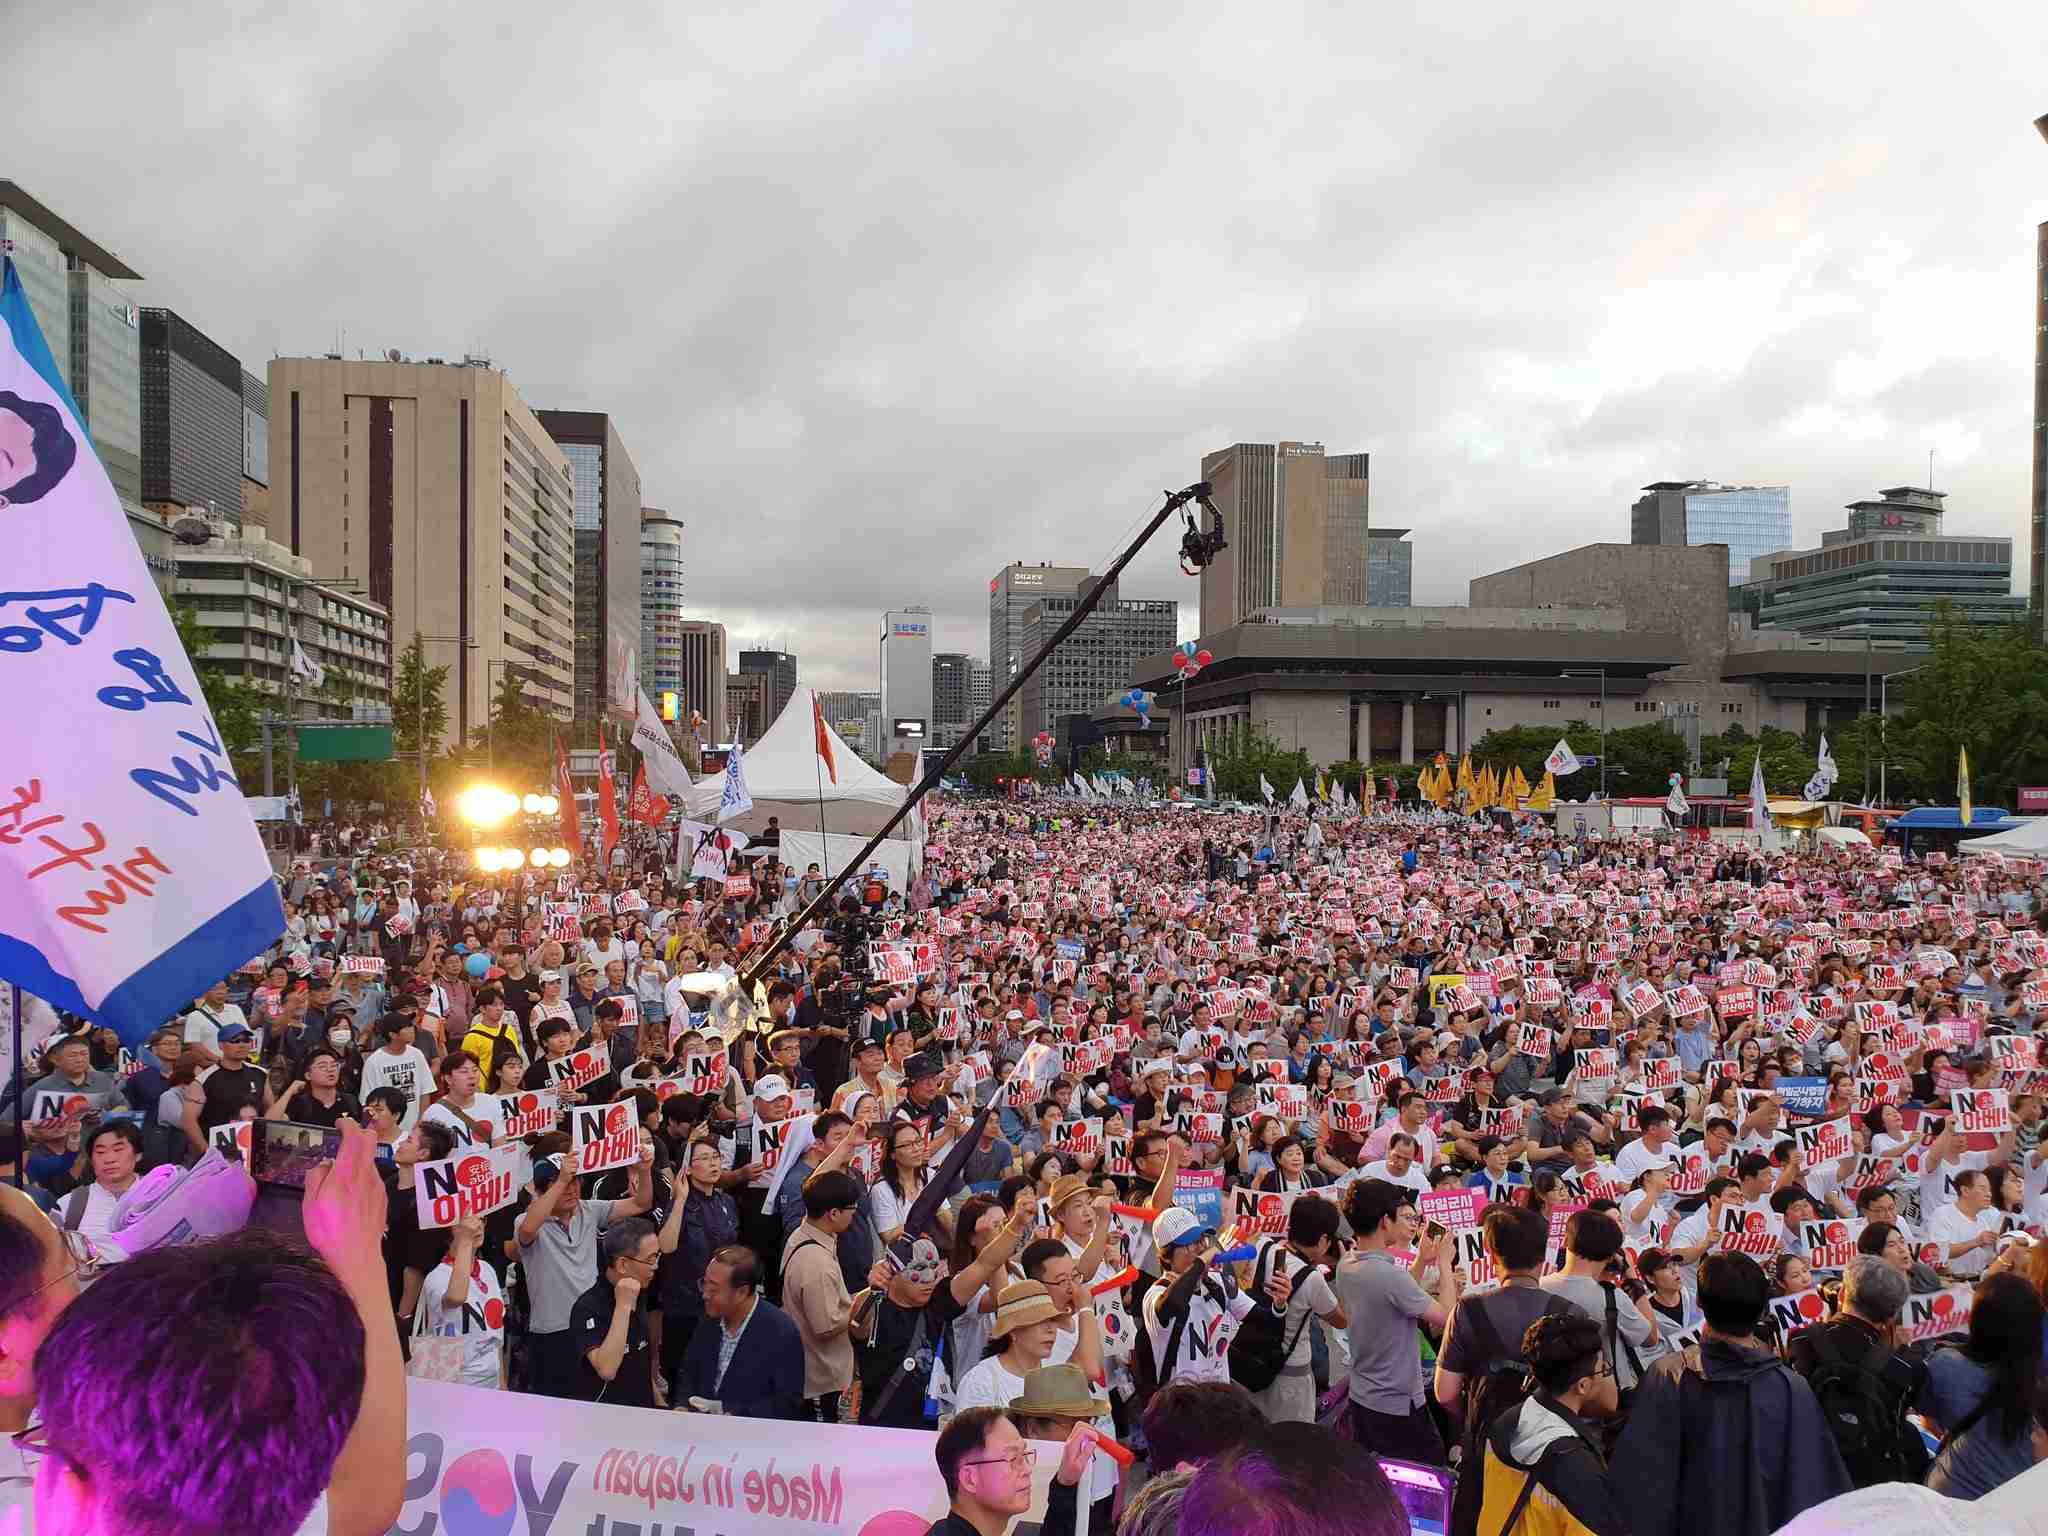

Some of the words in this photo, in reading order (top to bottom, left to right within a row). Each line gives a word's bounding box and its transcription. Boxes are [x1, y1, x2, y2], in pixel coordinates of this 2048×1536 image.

[1522, 1028, 1546, 1043] NO
[554, 1052, 592, 1080] NO
[1062, 1047, 1090, 1061] NO
[1577, 1050, 1600, 1066] NO
[1643, 1059, 1668, 1076] NO
[1425, 1078, 1451, 1092] NO
[1860, 1081, 1888, 1098] NO
[40, 1095, 90, 1119] NO
[500, 1093, 538, 1119] NO
[1333, 1103, 1362, 1118] NO
[1956, 1091, 1993, 1113] NO
[505, 1108, 552, 1137] 아베!
[580, 1104, 627, 1144] NO
[1055, 1122, 1088, 1141] NO
[1964, 1107, 2007, 1130] 아베!
[583, 1125, 639, 1170] 아베!
[1801, 1124, 1836, 1150] NO
[1806, 1135, 1849, 1165] 아베!
[423, 1156, 492, 1200] NO
[433, 1171, 511, 1225] 아베!
[1236, 1191, 1283, 1217] NO
[1725, 1209, 1765, 1233] NO
[1806, 1221, 1848, 1248] NO
[462, 1298, 504, 1334] NO
[1774, 1294, 1823, 1330] NO
[1911, 1295, 1953, 1324] NO
